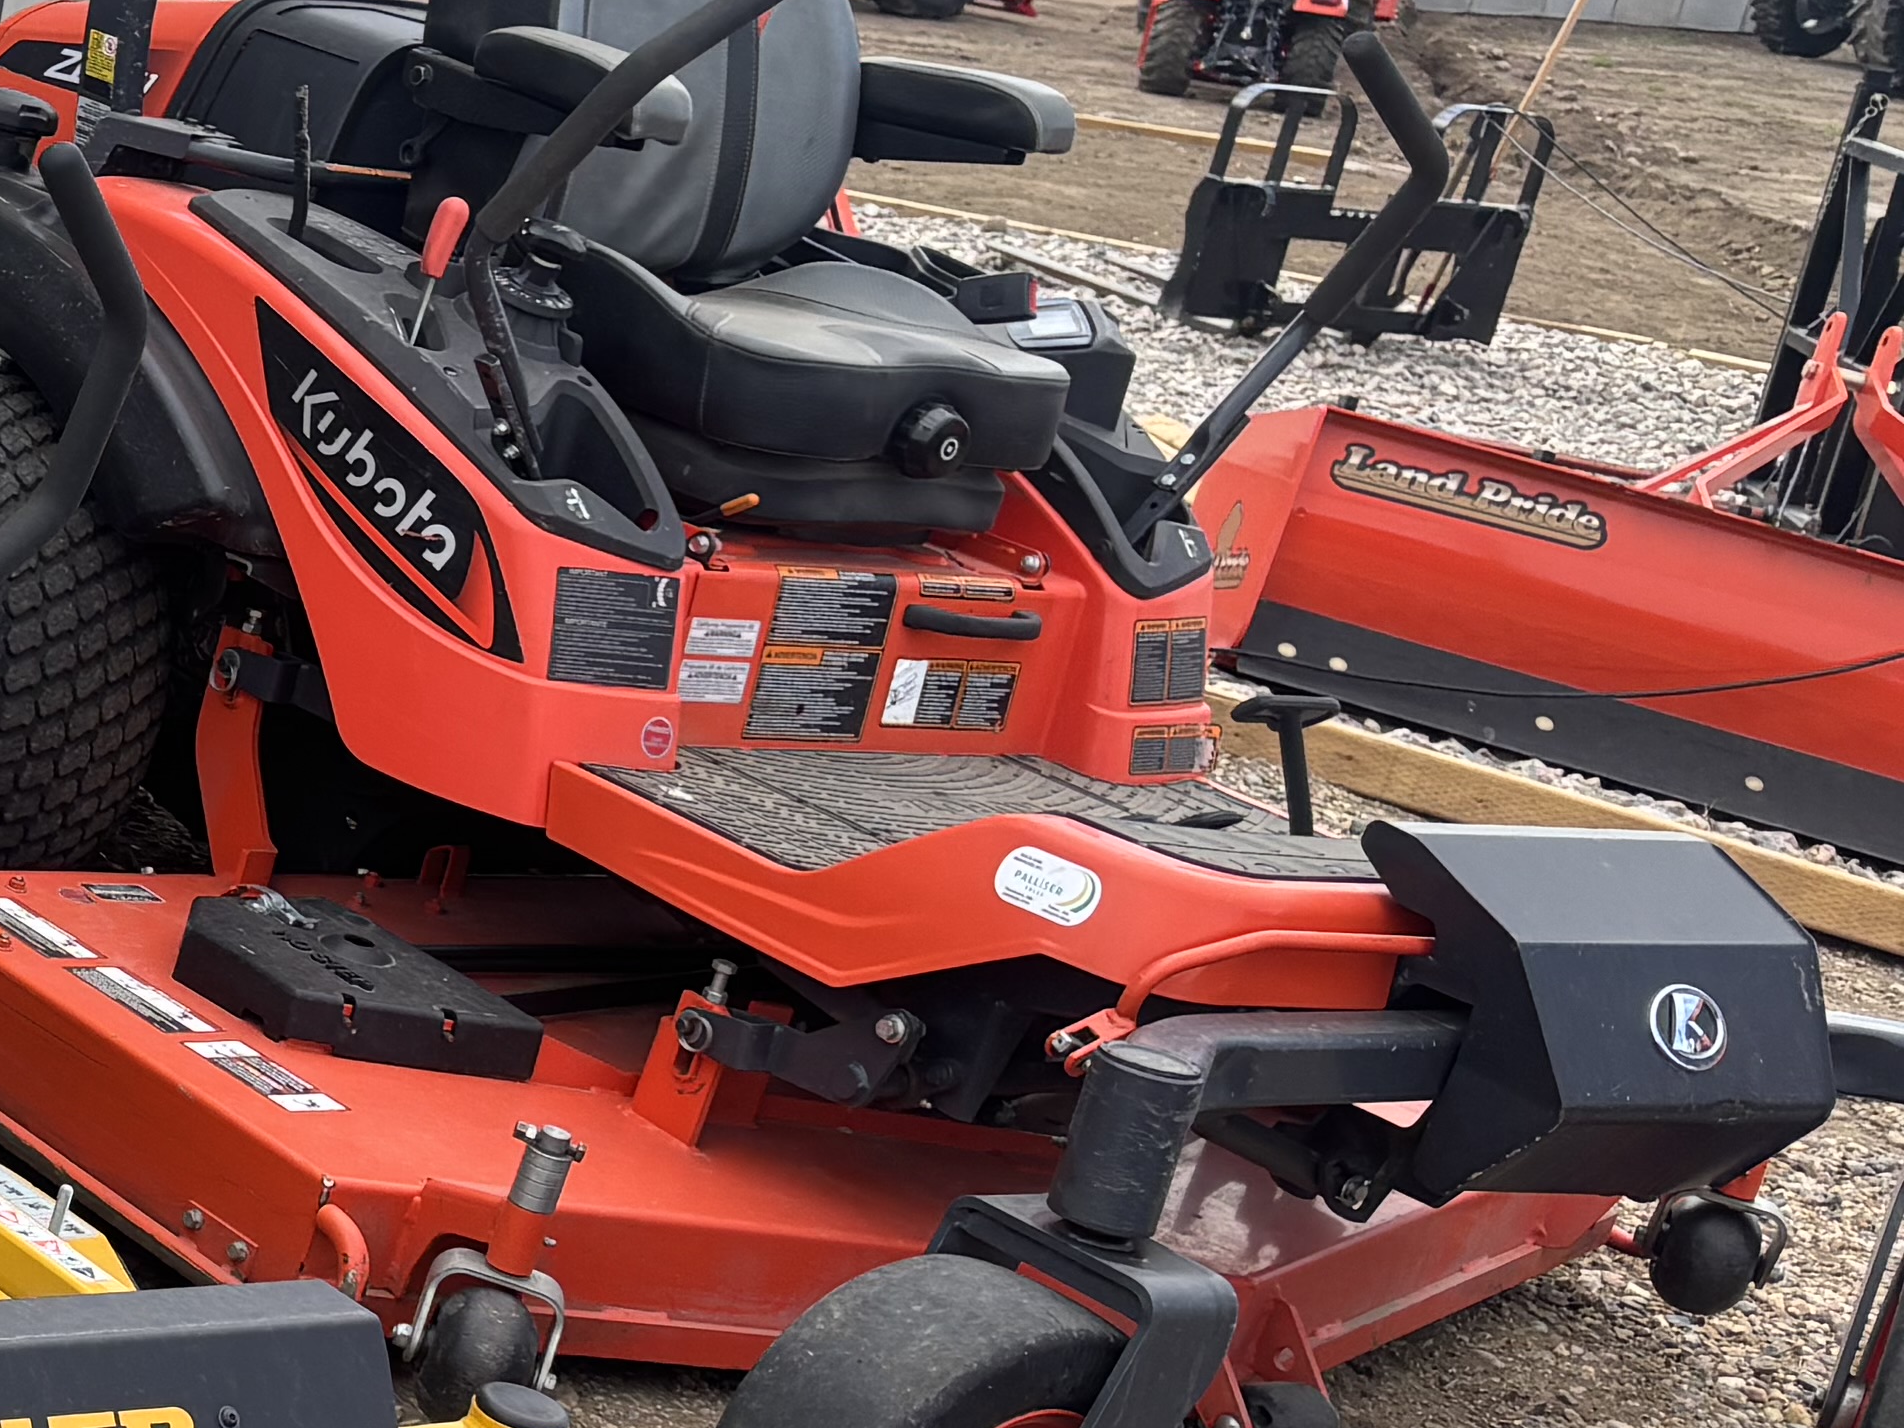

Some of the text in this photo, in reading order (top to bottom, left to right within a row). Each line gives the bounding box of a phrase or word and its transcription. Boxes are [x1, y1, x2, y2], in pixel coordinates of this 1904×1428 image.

[291, 368, 457, 571] Kubota
[1338, 445, 1602, 534] Land Pride
[1014, 869, 1064, 896] PALLISER
